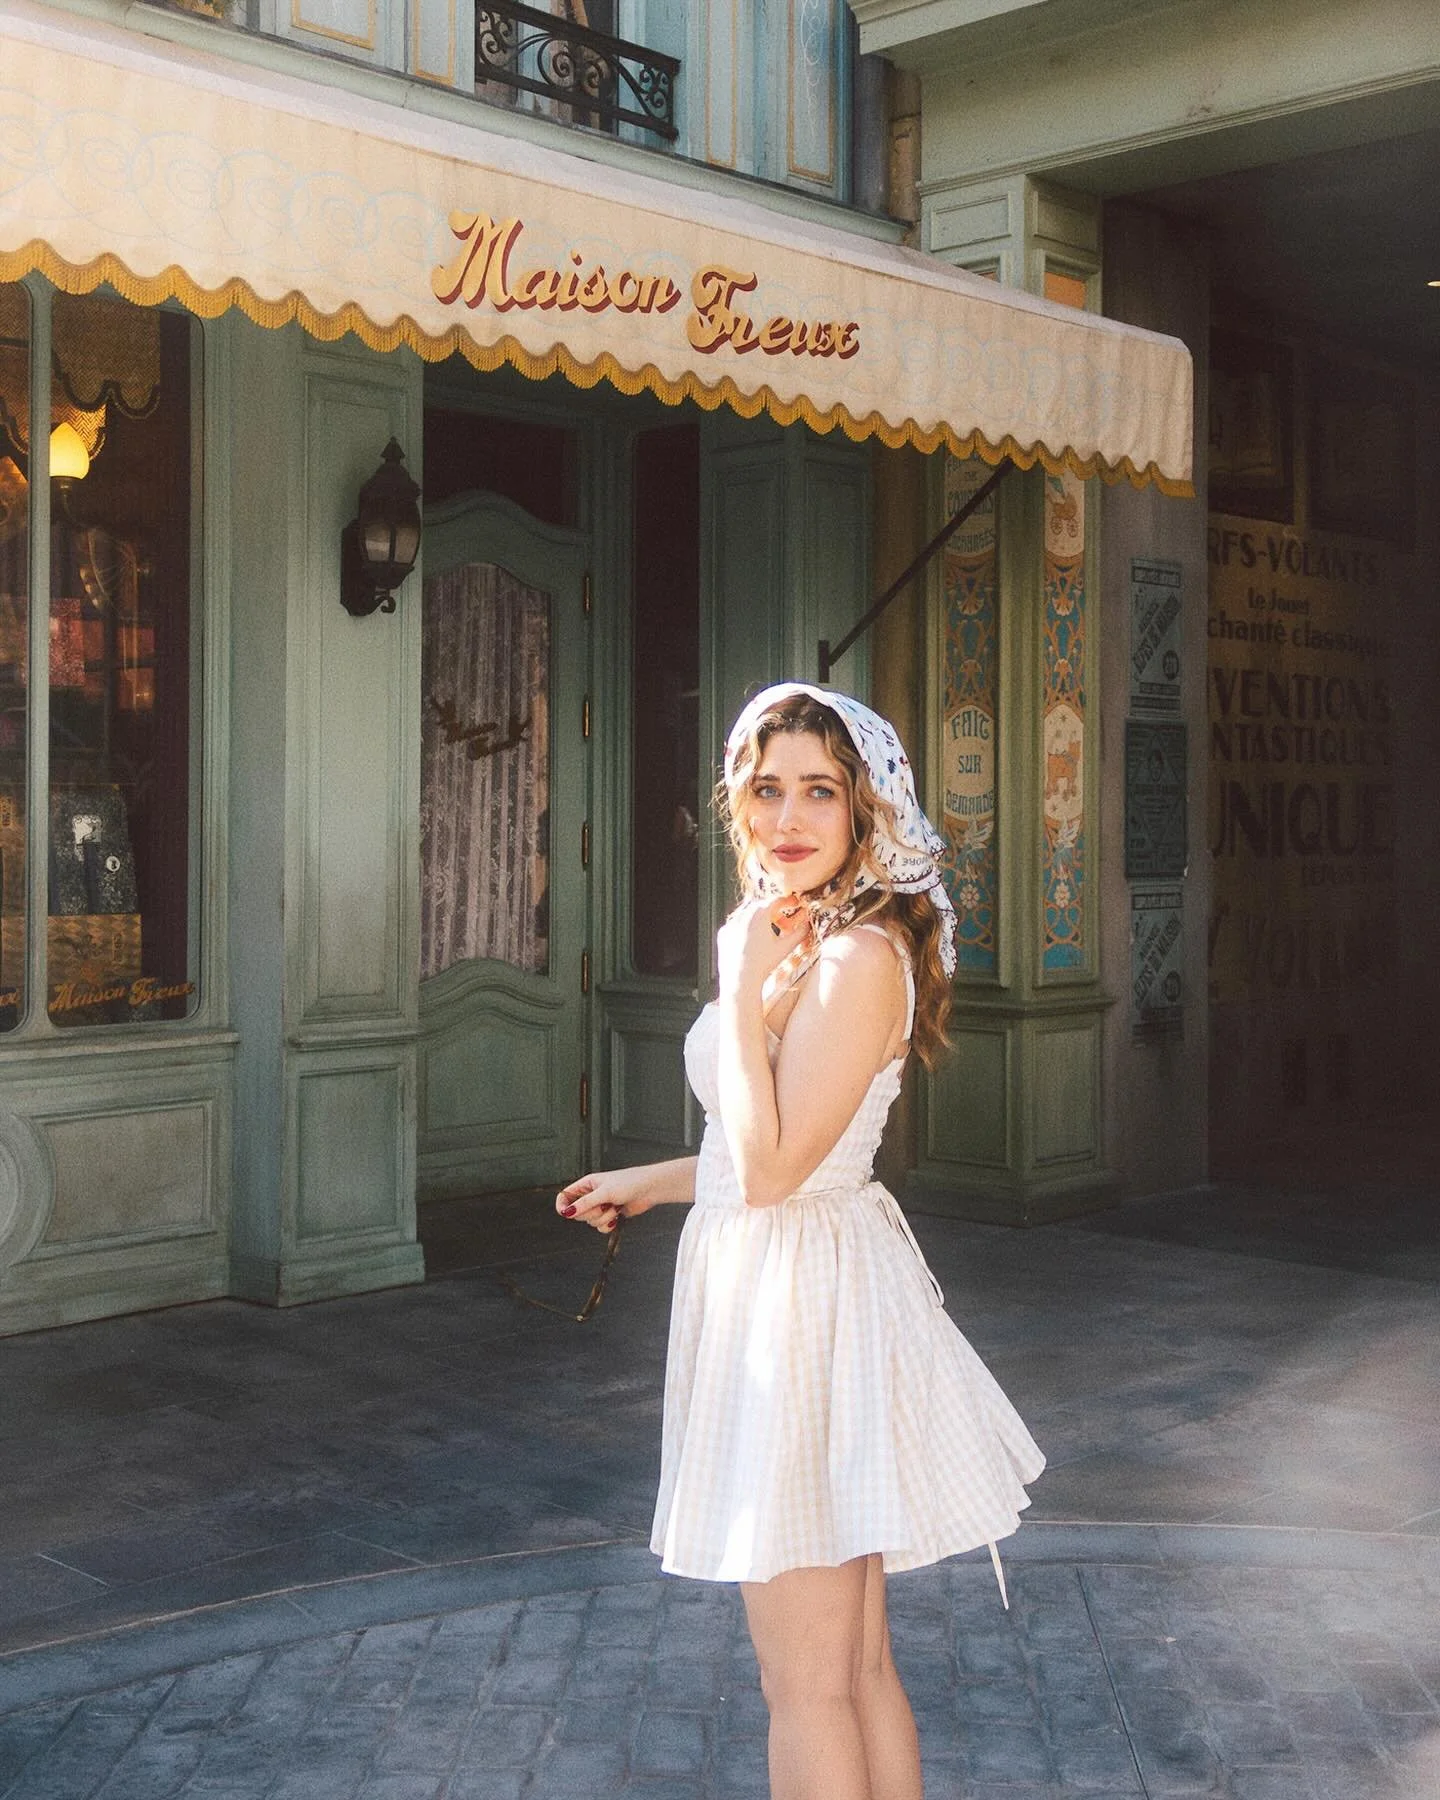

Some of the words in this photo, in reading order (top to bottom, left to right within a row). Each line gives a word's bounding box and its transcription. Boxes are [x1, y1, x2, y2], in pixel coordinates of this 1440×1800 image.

[431, 209, 681, 314] Maison
[1207, 667, 1391, 724] VENTIONS
[958, 754, 981, 774] SUR
